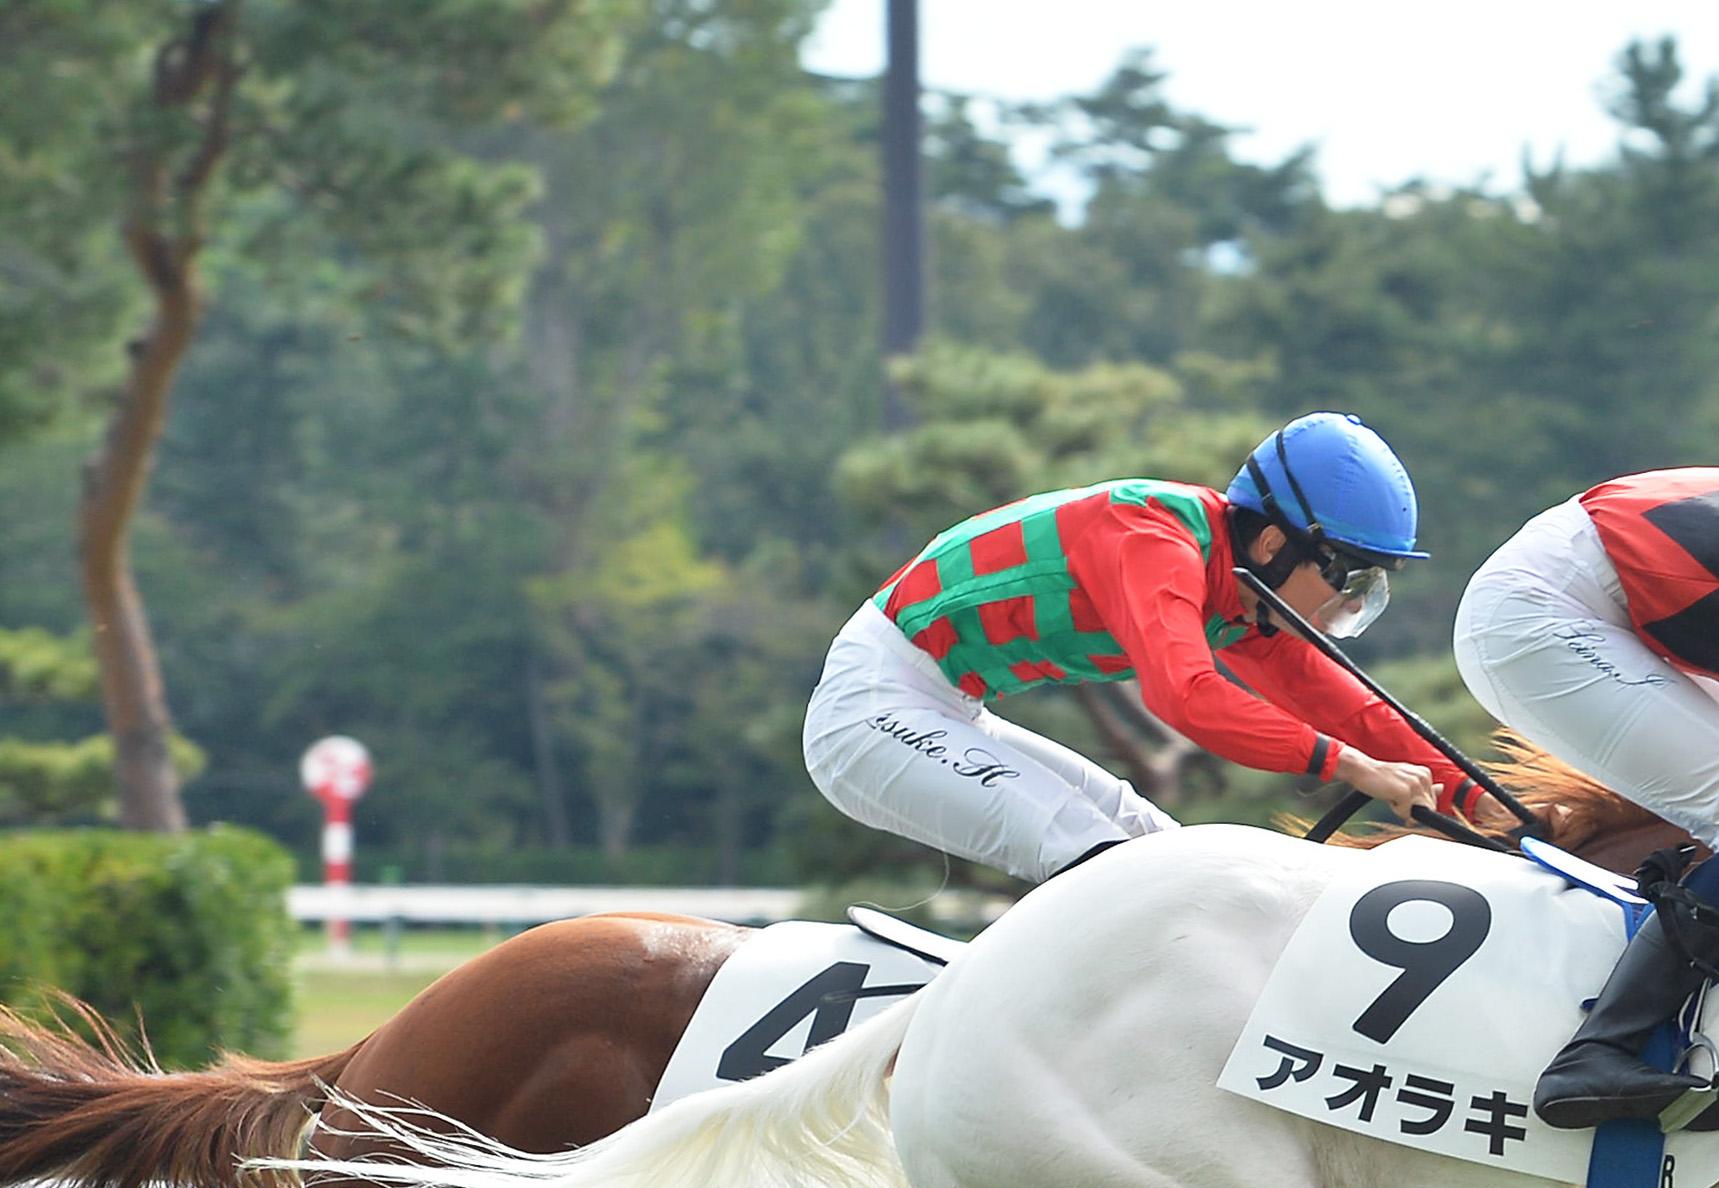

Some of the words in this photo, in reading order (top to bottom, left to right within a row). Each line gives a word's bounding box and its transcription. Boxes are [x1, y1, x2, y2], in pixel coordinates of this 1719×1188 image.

[716, 961, 871, 1082] 4
[1349, 879, 1492, 1044] 9
[1255, 1034, 1529, 1156] アオラキ
